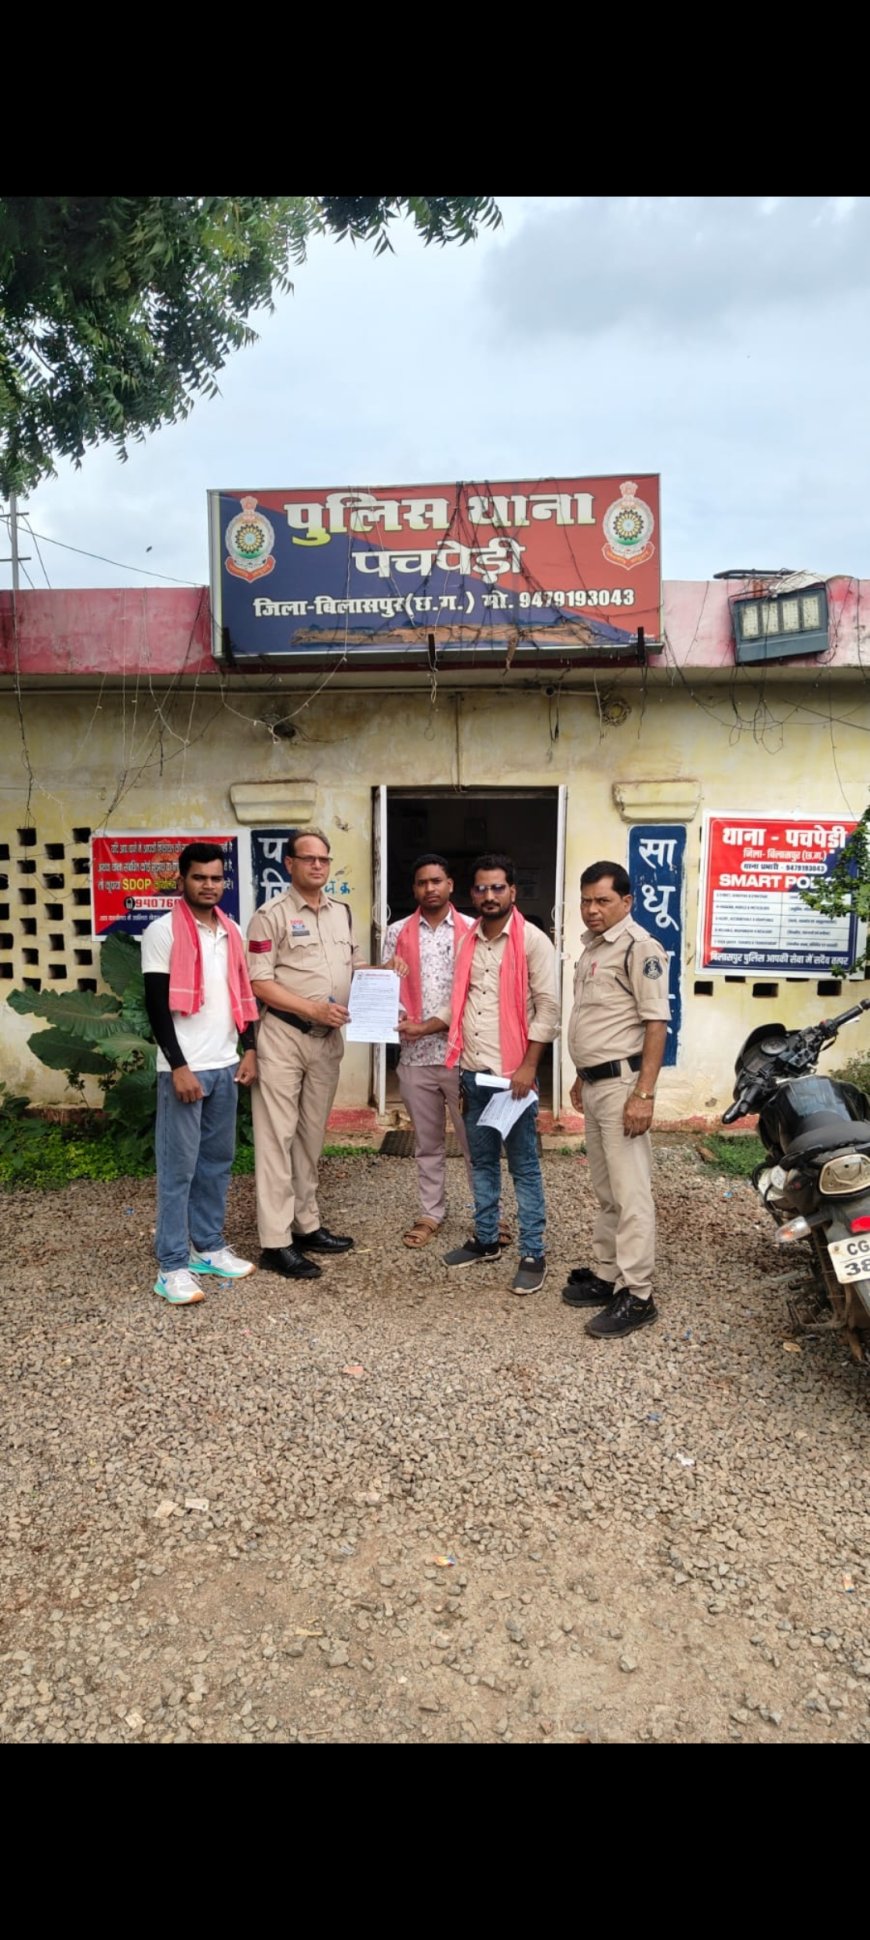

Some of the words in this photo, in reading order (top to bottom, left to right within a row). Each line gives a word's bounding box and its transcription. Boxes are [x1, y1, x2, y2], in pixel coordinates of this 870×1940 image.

[284, 493, 451, 546] पुलिस
[468, 491, 596, 527] थाना
[352, 537, 526, 584] पचपेड़ी
[482, 590, 514, 610] मो.
[519, 588, 635, 608] 9479193043
[722, 827, 767, 846] थाना
[122, 878, 152, 890] SDOP
[719, 873, 782, 888] SMART
[743, 951, 765, 965] पुलिस
[847, 1240, 870, 1256] CG
